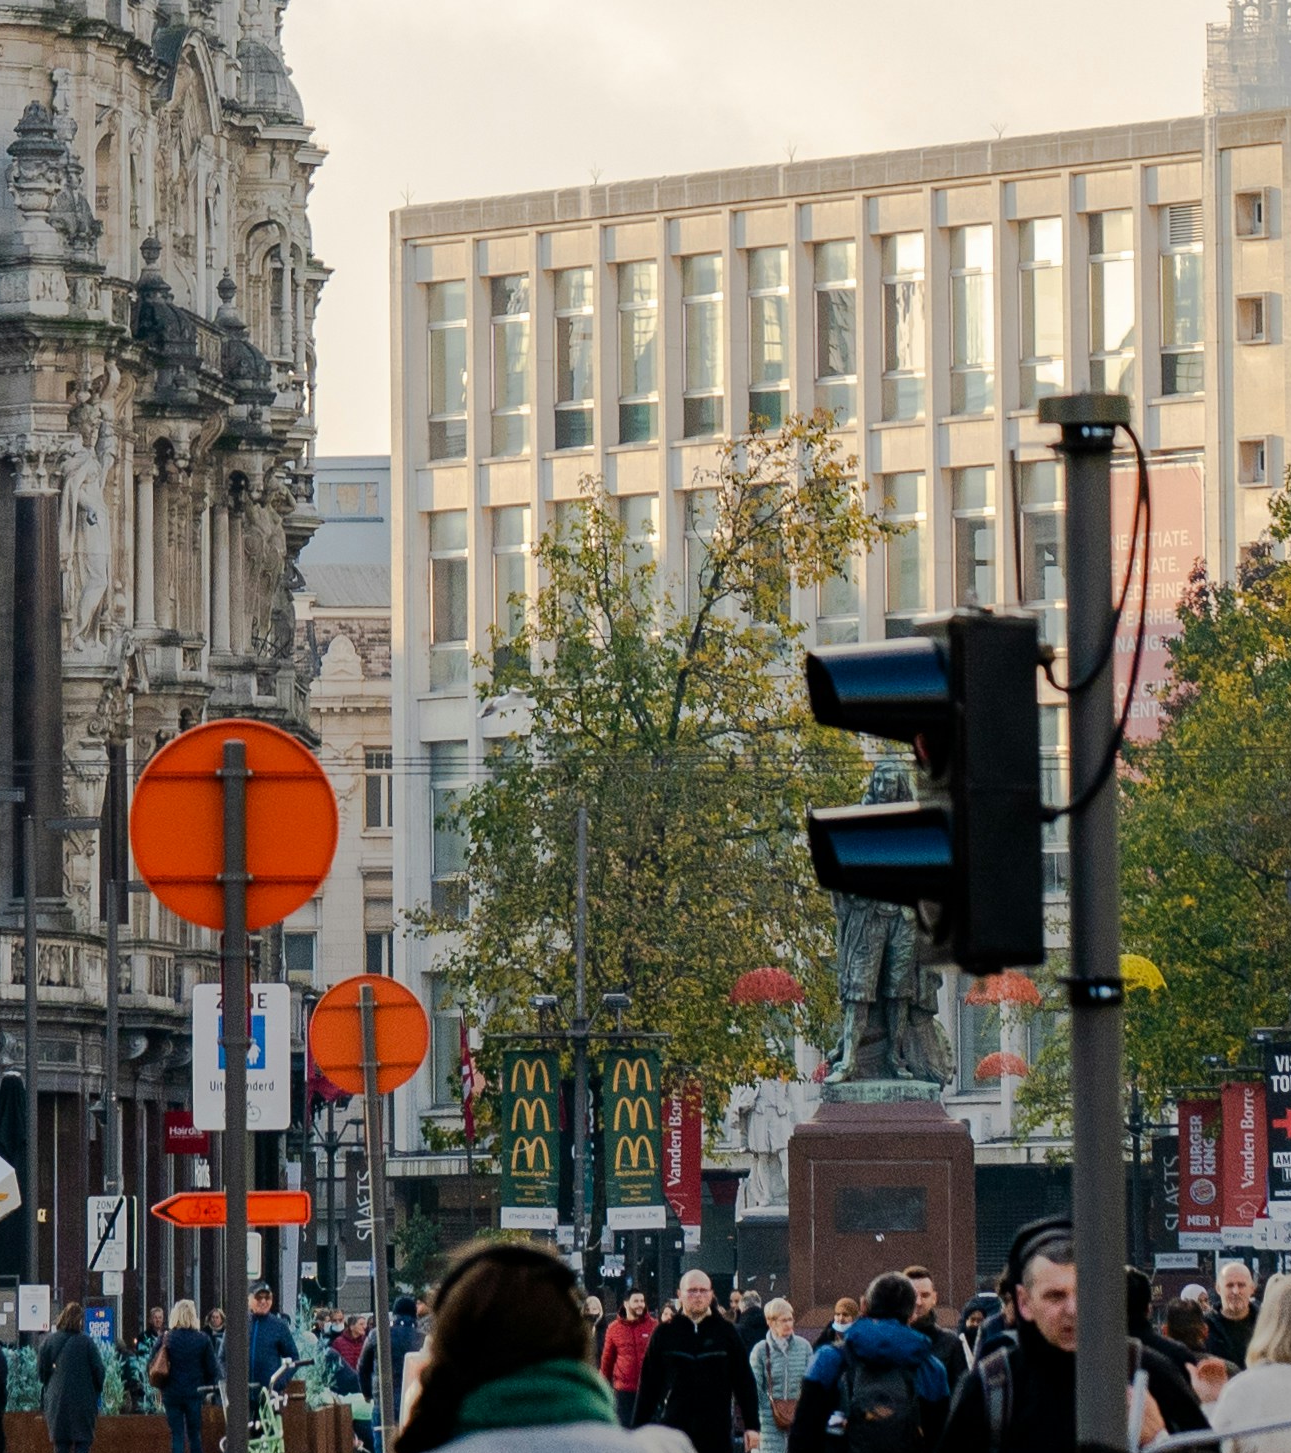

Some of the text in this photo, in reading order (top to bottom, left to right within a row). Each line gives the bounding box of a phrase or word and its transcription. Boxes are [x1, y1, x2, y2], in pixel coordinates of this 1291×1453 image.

[667, 1130, 682, 1187] Vanden
[1189, 1115, 1203, 1175] BURGER
[1203, 1137, 1216, 1175] KING
[1240, 1088, 1255, 1189] Vanden Borre
[1187, 1215, 1220, 1227] MEIR 1
